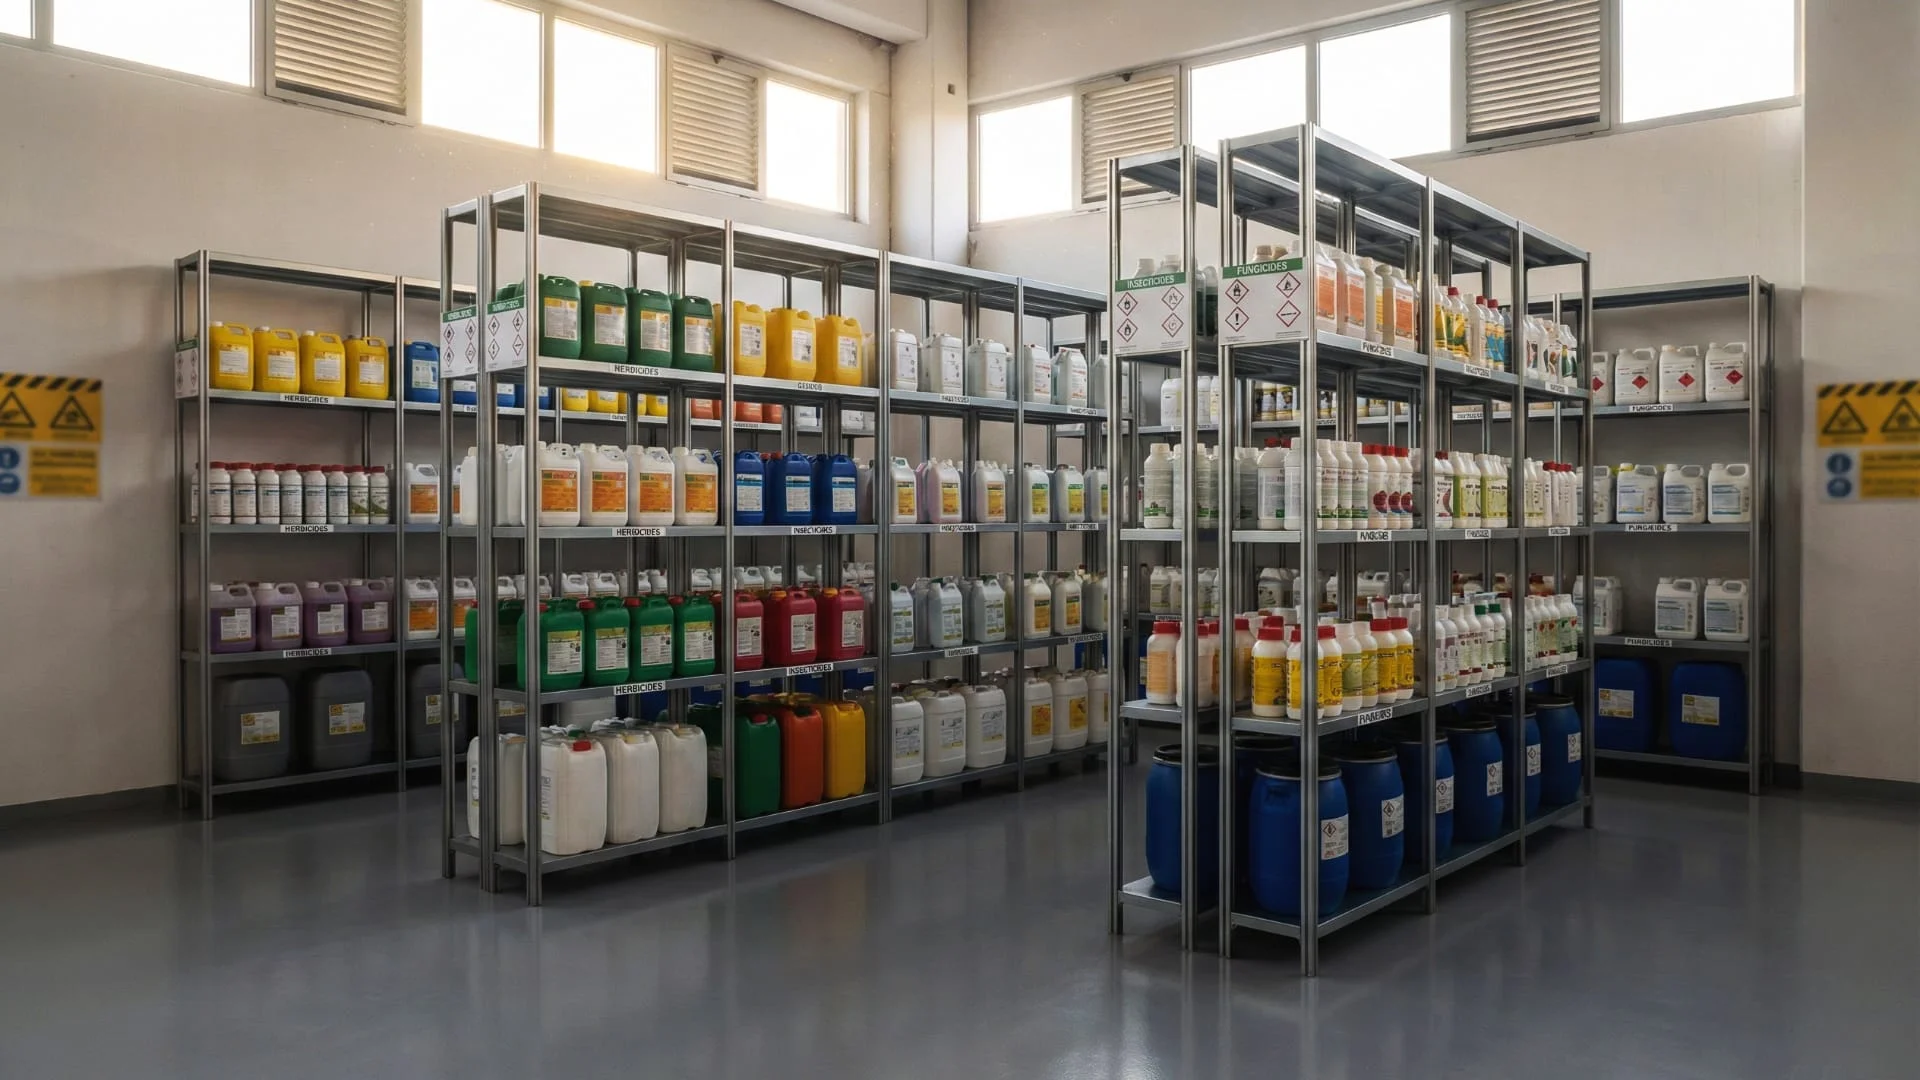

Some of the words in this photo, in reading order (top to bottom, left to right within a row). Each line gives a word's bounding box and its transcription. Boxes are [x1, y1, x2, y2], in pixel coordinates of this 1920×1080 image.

[1237, 261, 1288, 275] FUNGICIDES
[1127, 275, 1174, 289] INSECTICIDES
[616, 682, 663, 695] HERBICIDES
